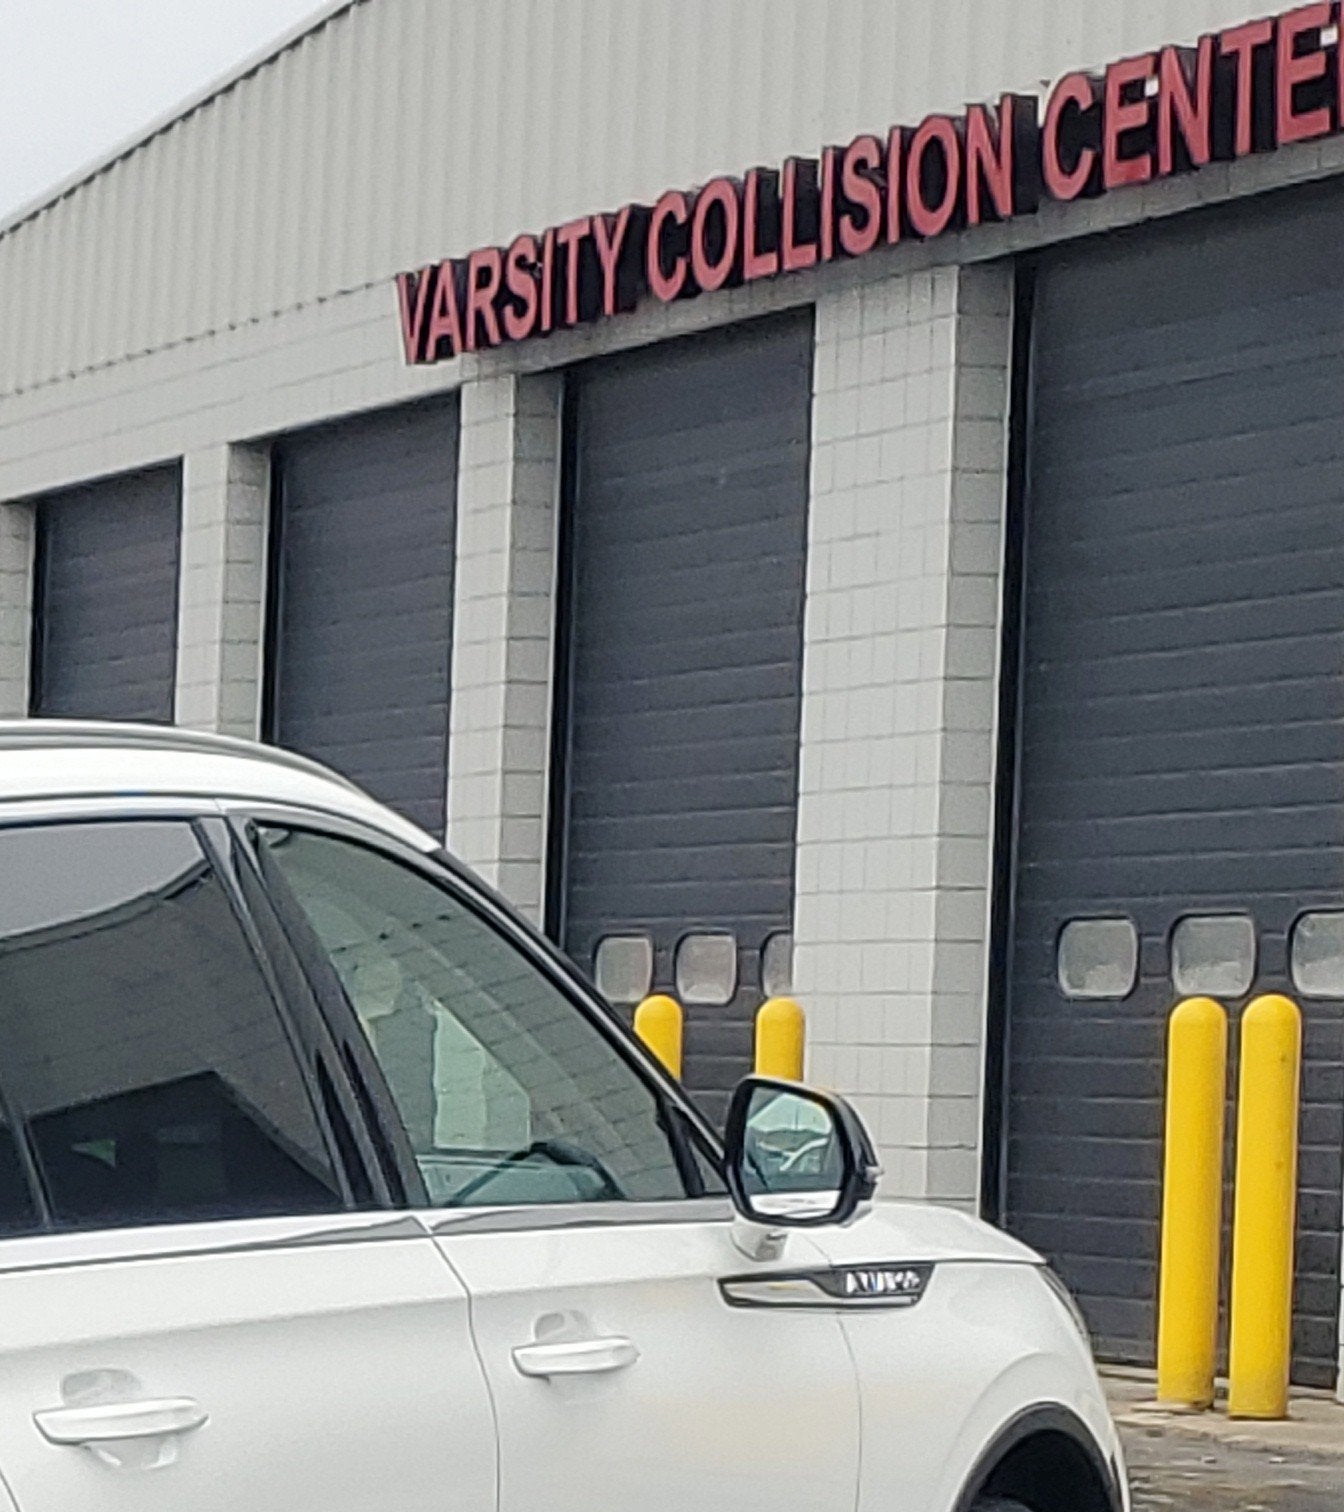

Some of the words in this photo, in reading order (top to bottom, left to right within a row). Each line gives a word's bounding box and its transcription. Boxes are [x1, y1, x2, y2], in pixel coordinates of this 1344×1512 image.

[395, 206, 634, 365] VARSITY
[647, 93, 1016, 301] COLLISION
[1042, 0, 1344, 200] CENTE
